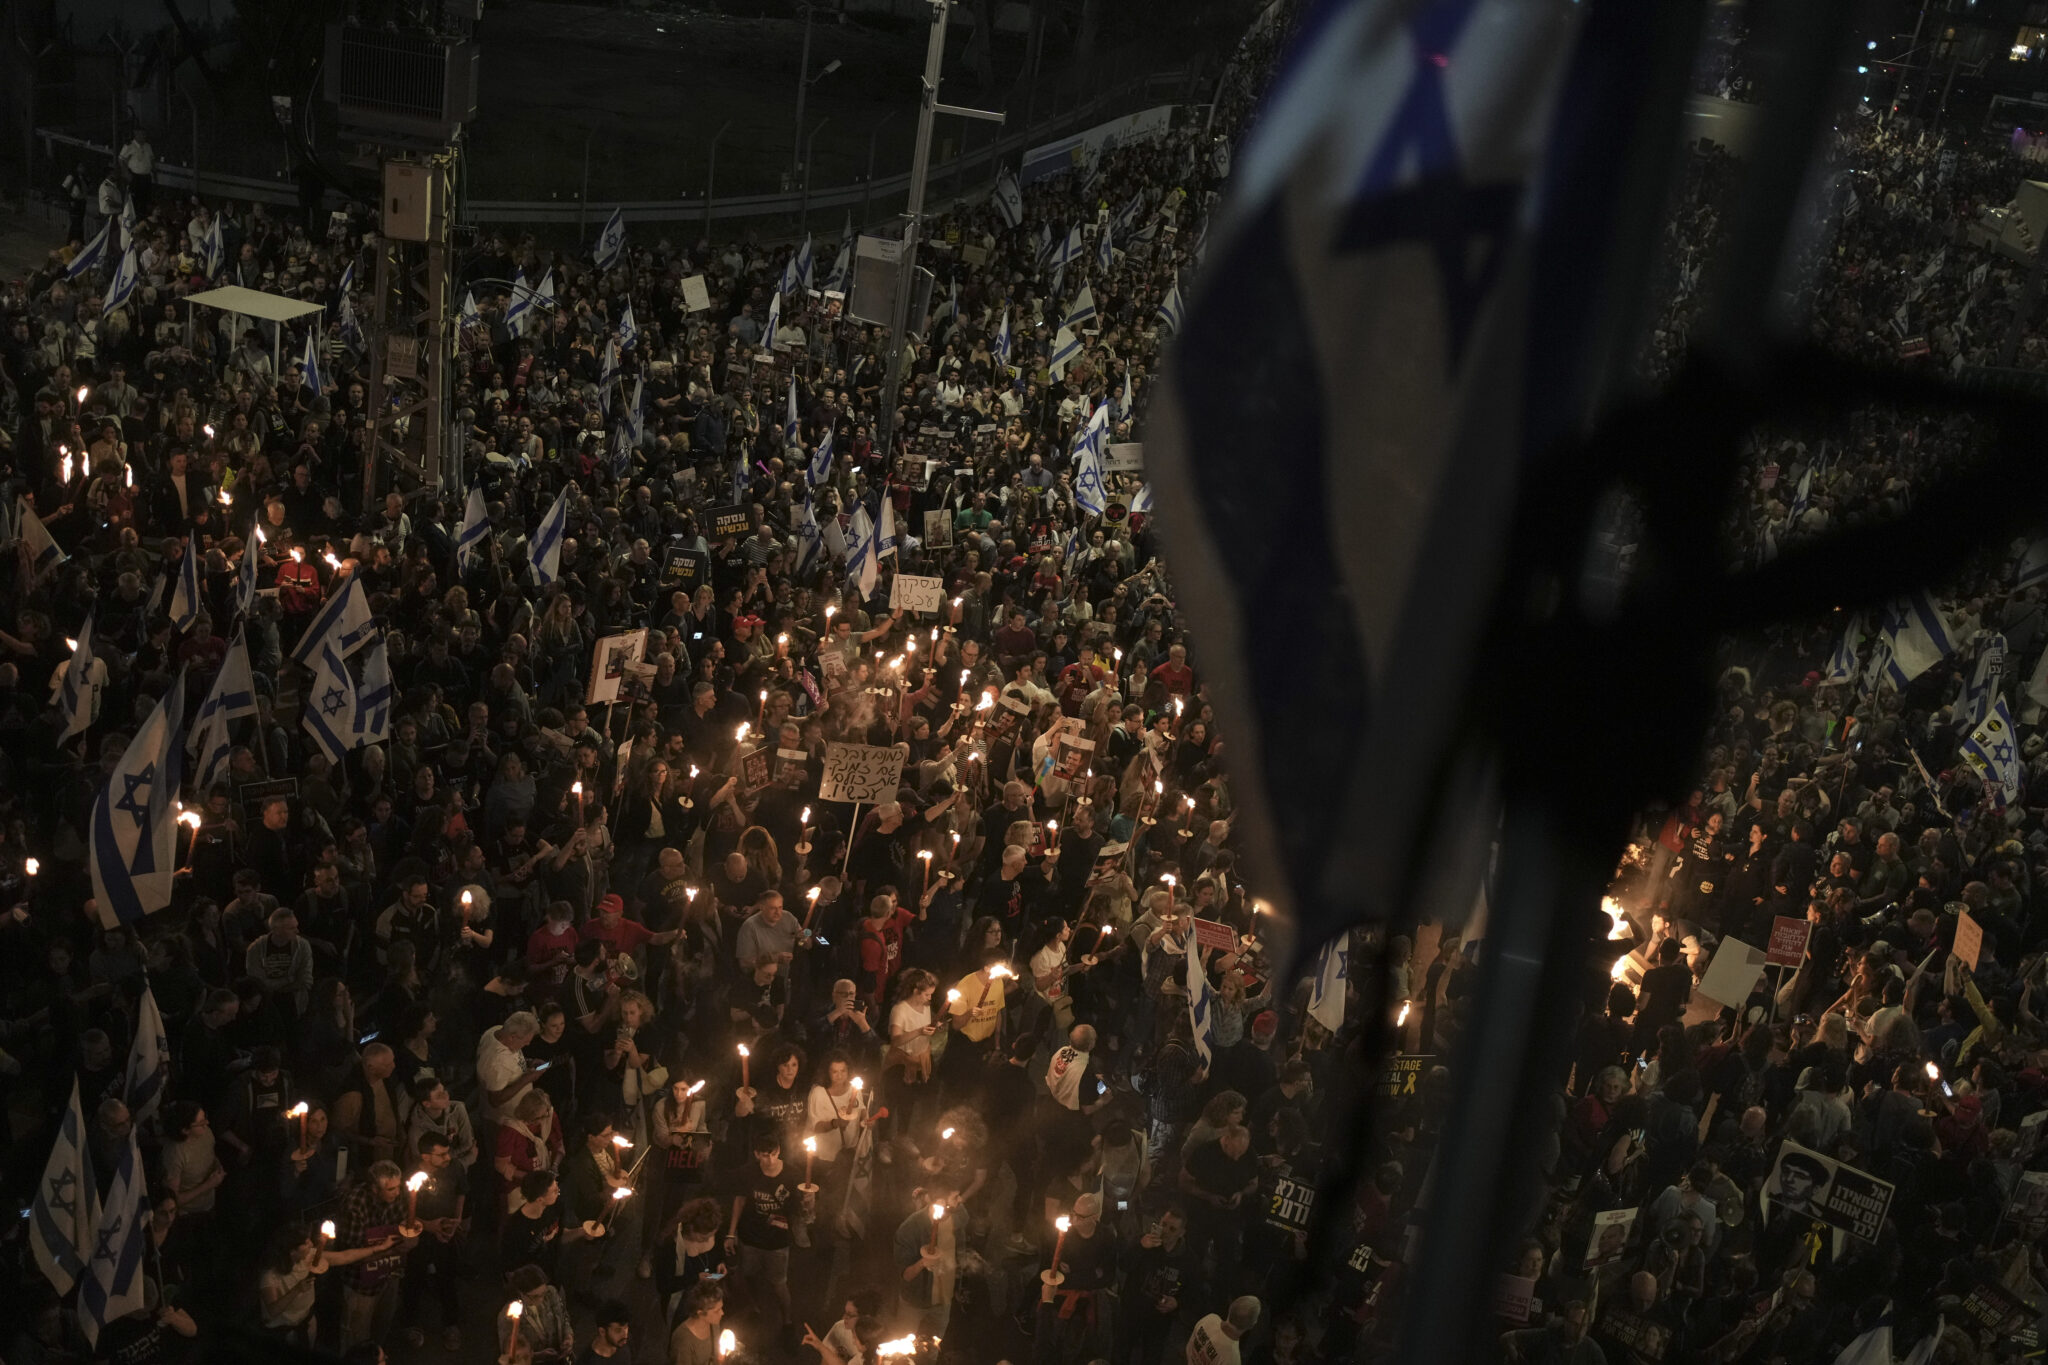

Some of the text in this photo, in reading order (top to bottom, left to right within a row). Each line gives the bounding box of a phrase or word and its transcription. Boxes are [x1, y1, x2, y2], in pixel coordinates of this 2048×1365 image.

[716, 513, 746, 526] עסקה
[716, 522, 749, 536] עכשיו!
[673, 557, 696, 568] עסקה
[898, 578, 941, 594] עסקה
[1275, 1178, 1315, 1206] עד לא
[1835, 1184, 1884, 1214] תשאירו
[1870, 1183, 1888, 1201] אל
[1270, 1195, 1310, 1225] נדע?
[1828, 1196, 1880, 1226] גם אותם
[1852, 1219, 1875, 1238] לבד
